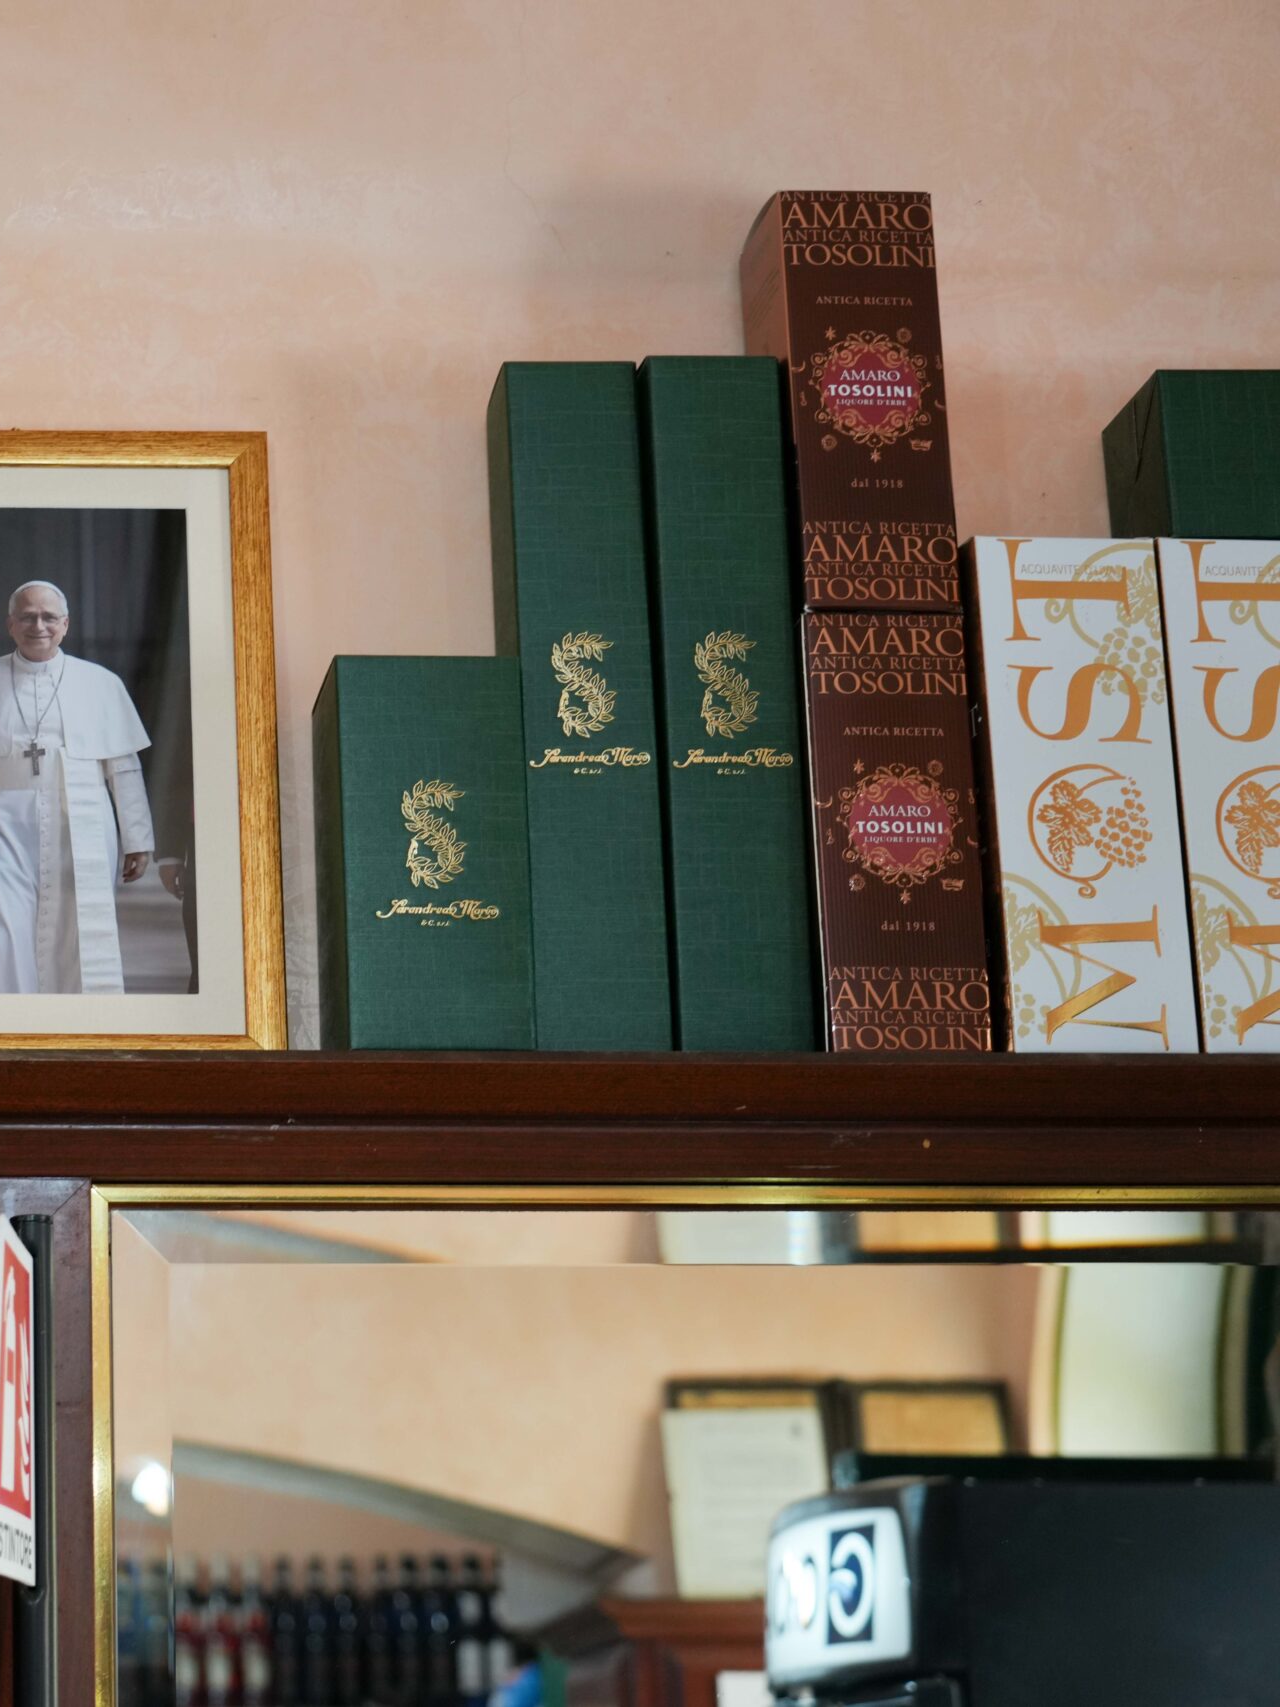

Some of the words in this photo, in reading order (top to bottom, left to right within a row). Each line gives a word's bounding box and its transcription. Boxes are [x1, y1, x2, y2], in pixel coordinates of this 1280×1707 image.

[781, 192, 848, 202] ANTICA
[783, 202, 932, 232] AMARO
[783, 230, 852, 243] ANTICA
[858, 230, 934, 245] RICETTA
[784, 243, 936, 268] TOSOLINI
[816, 296, 860, 305] ANTICA
[864, 296, 913, 306] RICETTA
[840, 369, 900, 382] AMARO
[828, 384, 913, 398] TOSOLINI
[836, 398, 874, 406] LIQUORE
[851, 478, 870, 488] dal
[874, 479, 904, 488] 1918
[802, 520, 872, 535] ANTICA
[879, 522, 956, 537] RICETTA
[803, 534, 958, 565] AMARO
[804, 562, 878, 576] ANTICA
[882, 563, 958, 578] RICETTA
[804, 576, 960, 602] TOSOLINI
[808, 614, 880, 628] ANTICA
[886, 614, 964, 628] RICETTA
[810, 627, 964, 657] AMARO
[812, 656, 883, 670] ANTICA
[890, 657, 966, 671] RICETTA
[810, 671, 968, 696] TOSOLINI
[843, 726, 890, 736] ANTICA
[893, 727, 944, 737] RICETTA
[868, 804, 931, 818] AMARO
[856, 820, 944, 834] TOSOLINI
[864, 836, 904, 844] LIQUORE
[906, 836, 938, 844] D'ERBE
[881, 920, 900, 931] dal
[906, 921, 936, 932] 1918
[830, 966, 902, 980] ANTICA
[910, 967, 988, 982] RICETTA
[831, 980, 990, 1012] AMARO
[833, 1010, 906, 1024] ANTICA
[913, 1010, 992, 1026] RICETTA
[833, 1025, 992, 1052] TOSOLINI
